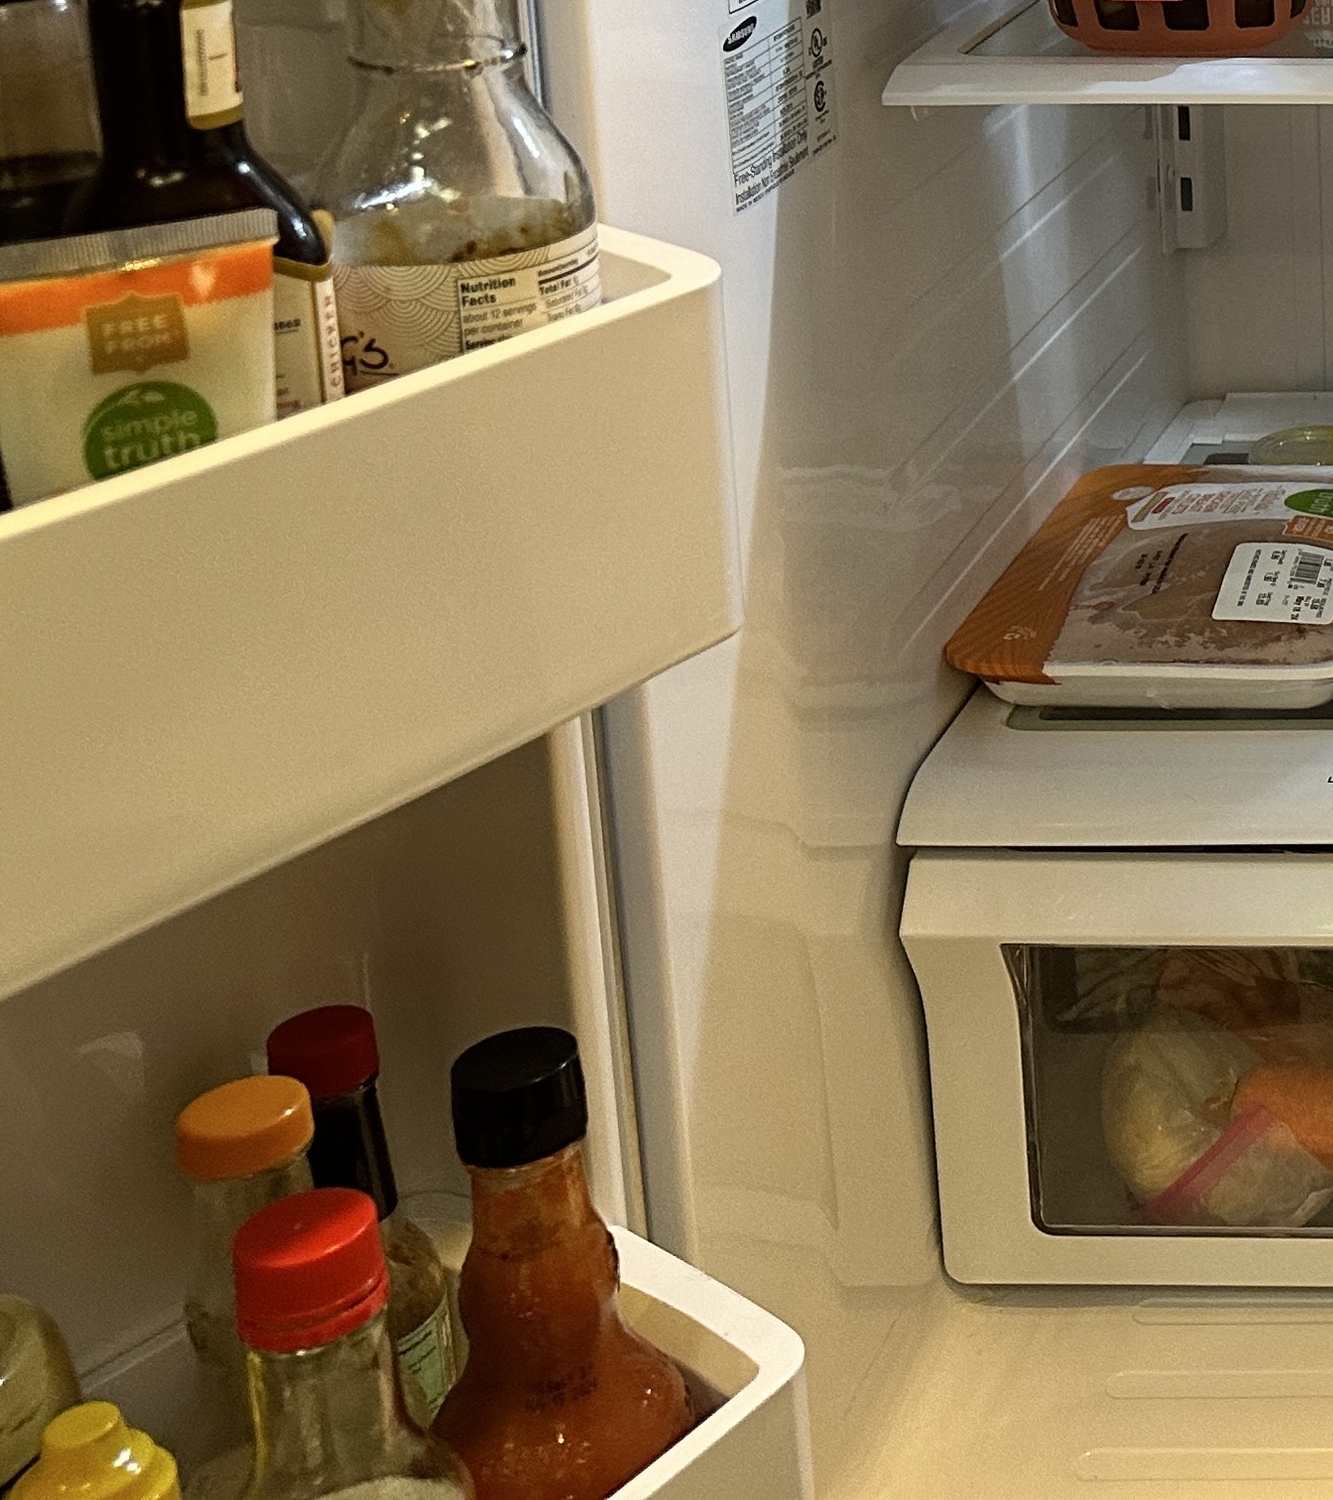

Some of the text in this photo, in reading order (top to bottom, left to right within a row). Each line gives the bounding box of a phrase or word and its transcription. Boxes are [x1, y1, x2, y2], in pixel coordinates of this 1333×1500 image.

[460, 277, 516, 294] Nutrition
[462, 293, 497, 307] Facts
[463, 303, 537, 324] about 12 servings
[101, 312, 169, 337] FREE
[464, 318, 524, 338] per container
[101, 405, 197, 446] simple
[104, 424, 200, 470] truth
